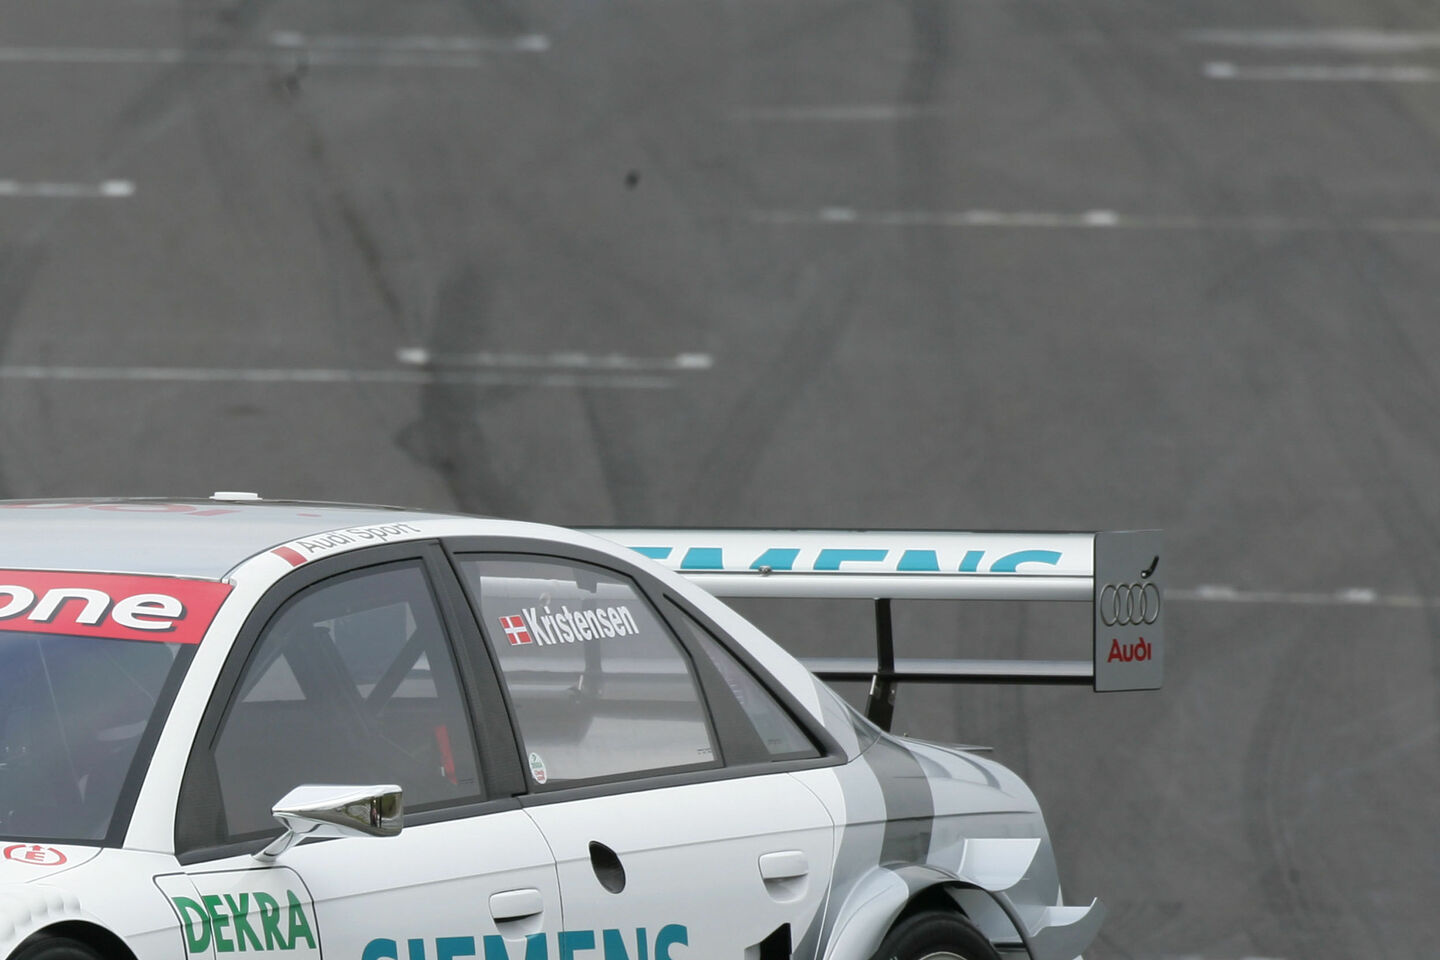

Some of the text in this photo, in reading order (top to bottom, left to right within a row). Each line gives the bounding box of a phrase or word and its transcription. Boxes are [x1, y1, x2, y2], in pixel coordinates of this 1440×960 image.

[296, 522, 421, 553] Audi Sport
[522, 605, 640, 646] Kristensen
[1107, 637, 1152, 663] Audi
[171, 889, 317, 953] DEKRA
